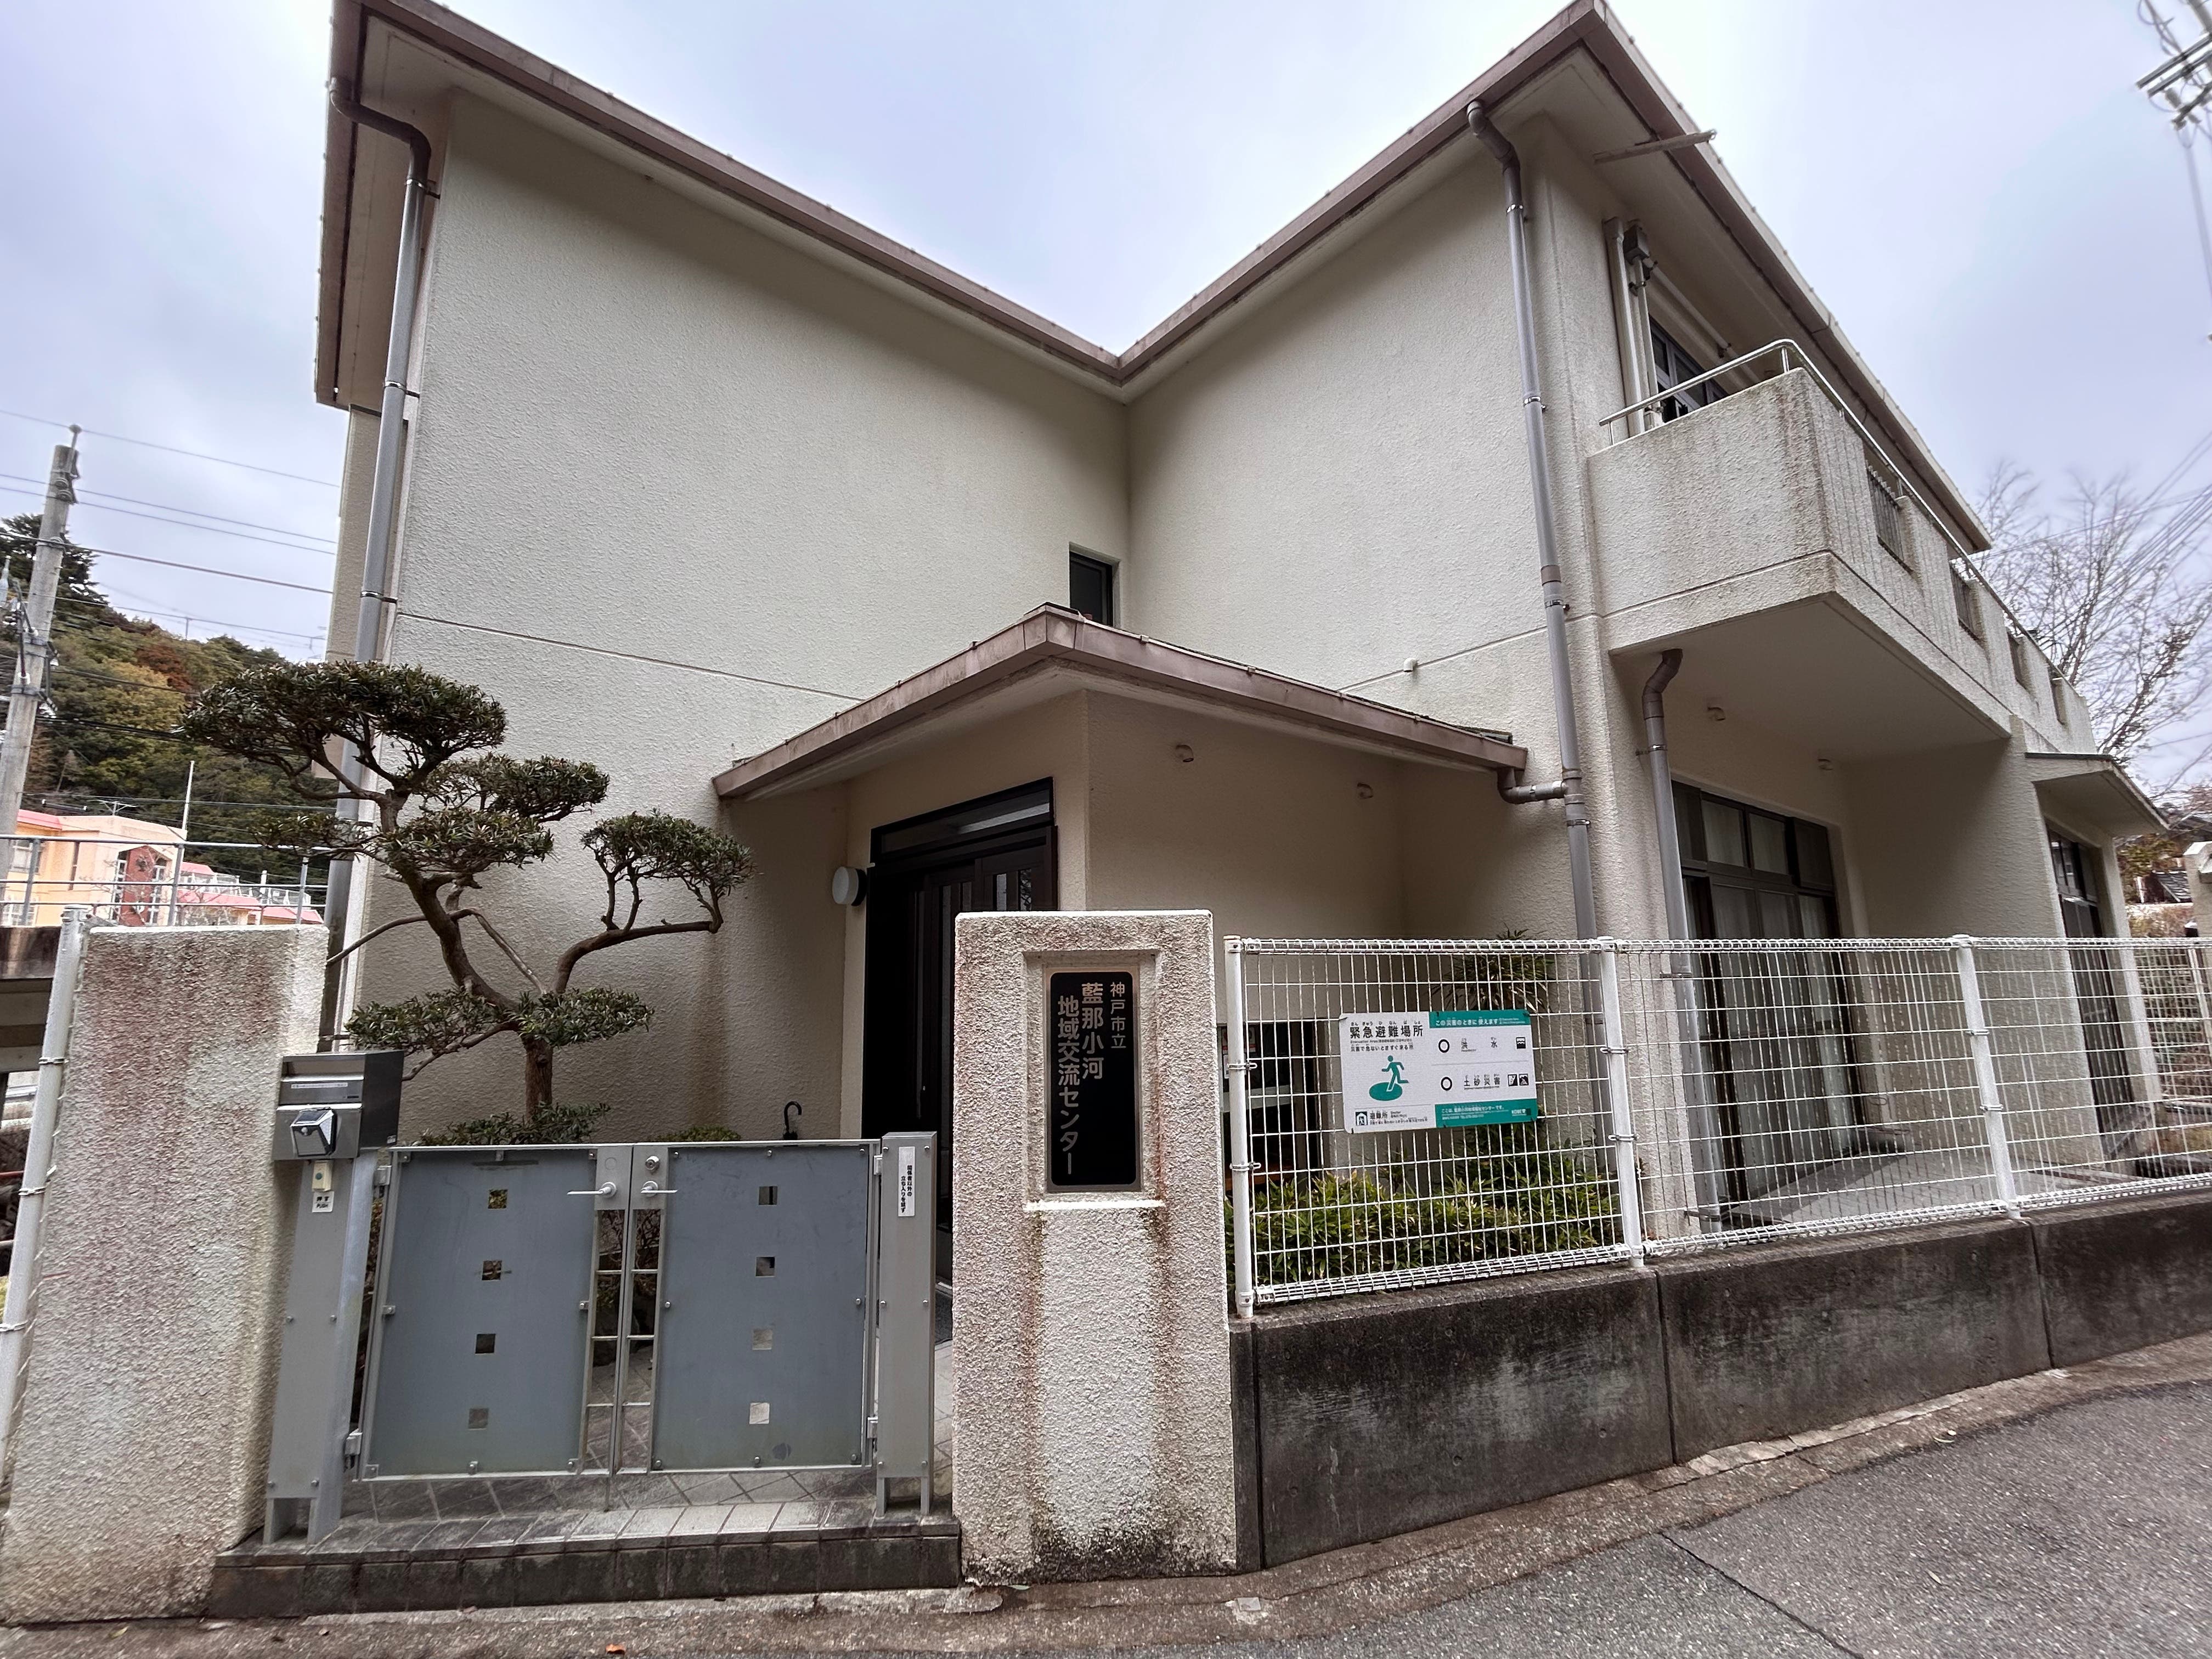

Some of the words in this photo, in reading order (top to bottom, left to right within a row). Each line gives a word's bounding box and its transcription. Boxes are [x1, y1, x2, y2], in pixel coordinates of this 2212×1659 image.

[1081, 982, 1104, 1080] 藍那小河
[1110, 981, 1127, 1049] 神戸市立
[1350, 1025, 1423, 1039] 緊急避難場所
[1057, 995, 1080, 1175] 地域交流センター
[1464, 1077, 1500, 1086] 土砂災害
